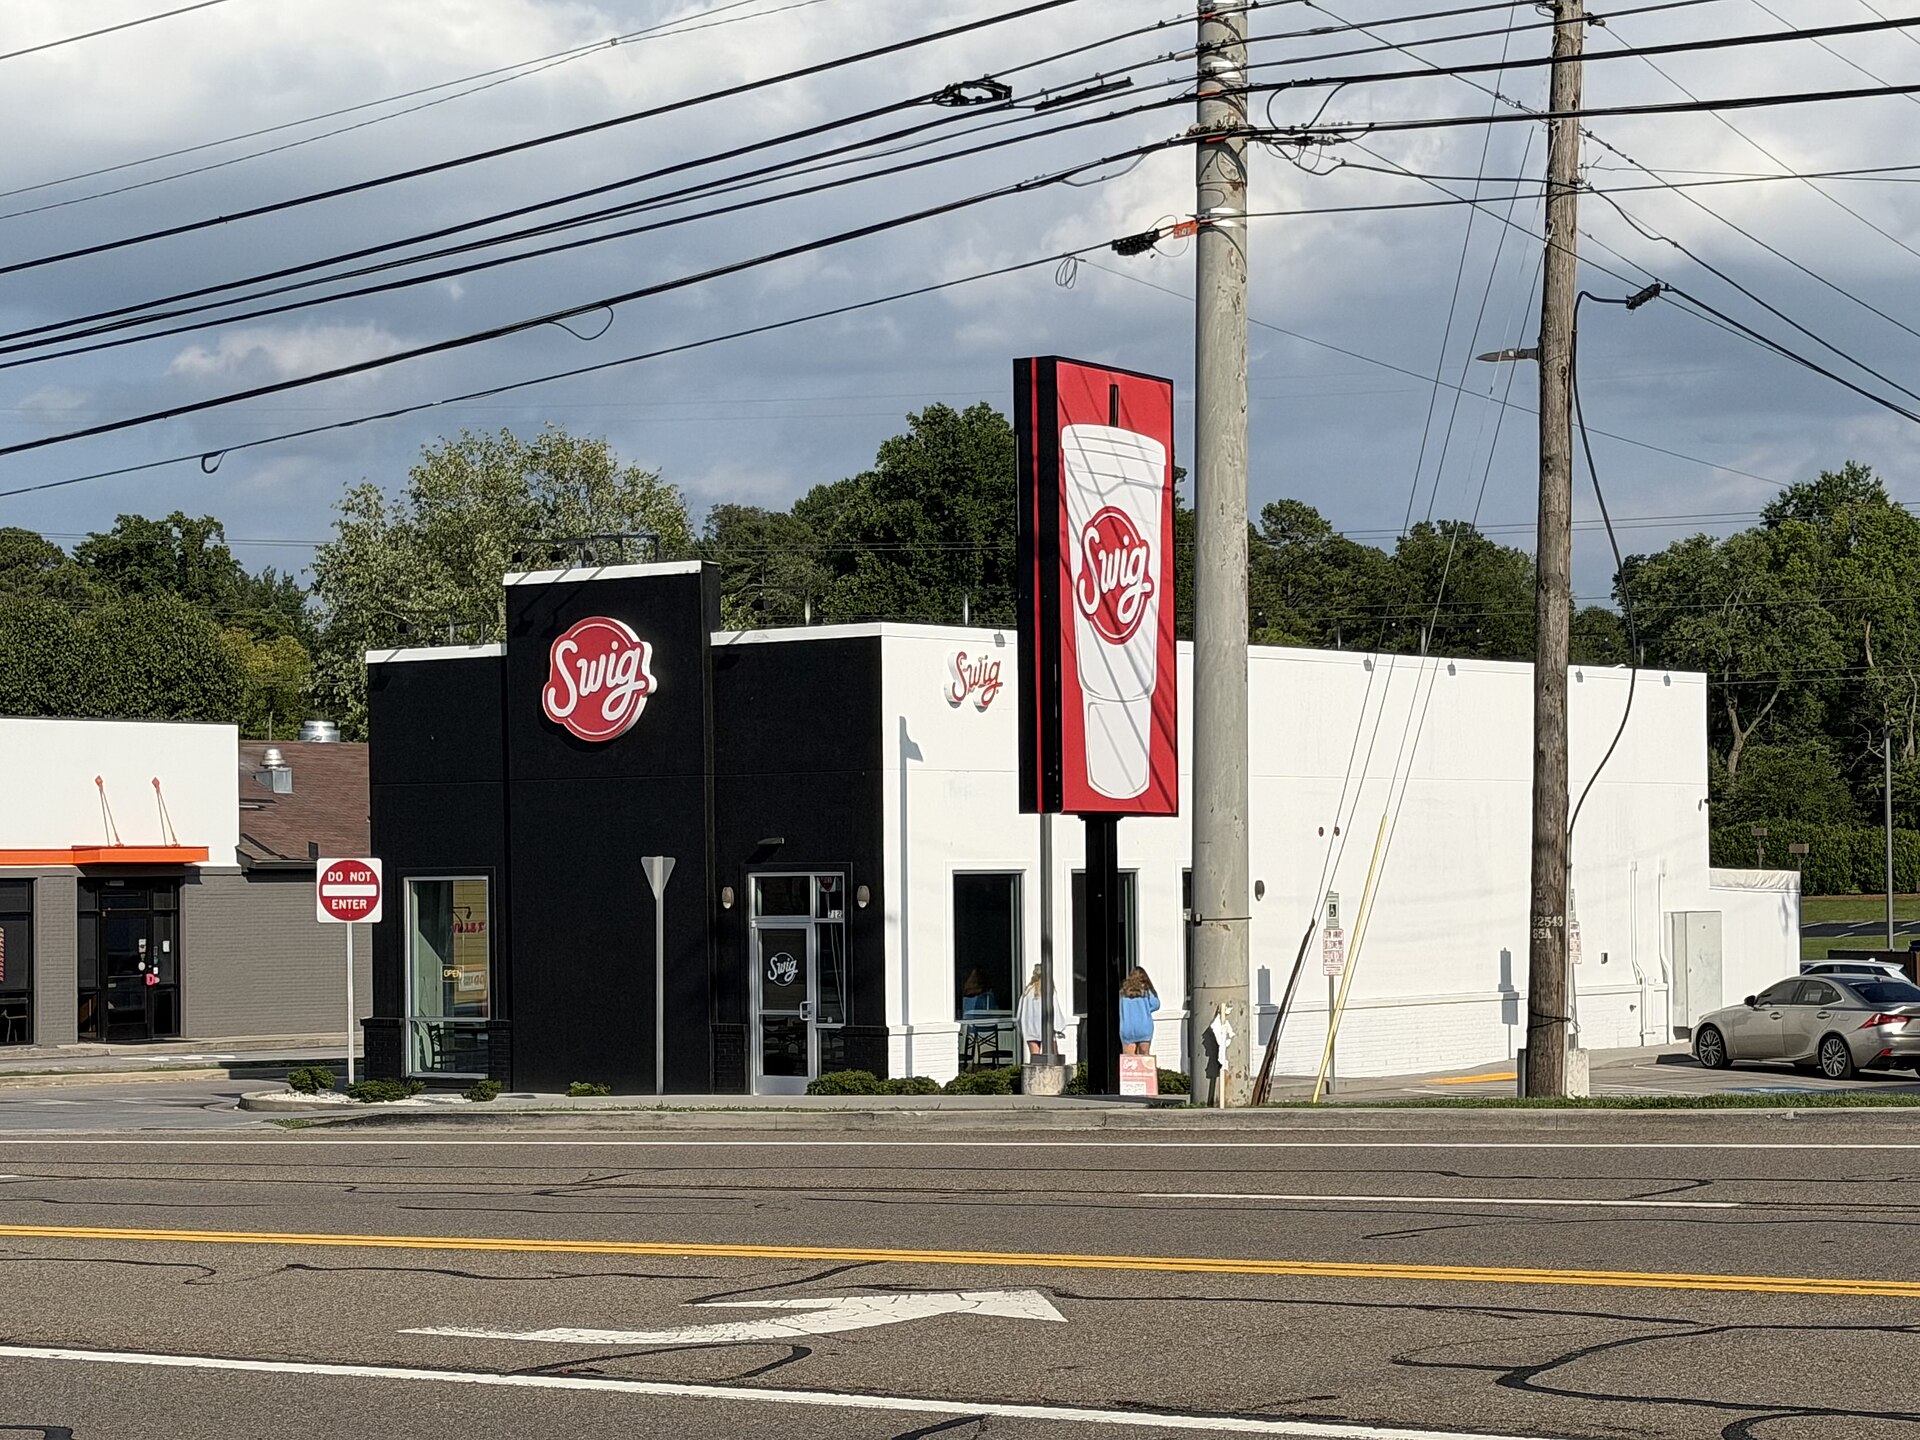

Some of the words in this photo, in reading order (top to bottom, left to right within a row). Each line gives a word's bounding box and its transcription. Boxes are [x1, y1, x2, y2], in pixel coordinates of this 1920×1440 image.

[1079, 526, 1152, 625] Swig
[547, 639, 646, 721] Swig
[951, 651, 1003, 706] Swig
[327, 871, 343, 882] DO
[349, 871, 371, 882] NOT
[331, 899, 367, 910] ENTER
[443, 969, 462, 978] OPEN
[767, 956, 799, 982] Swig
